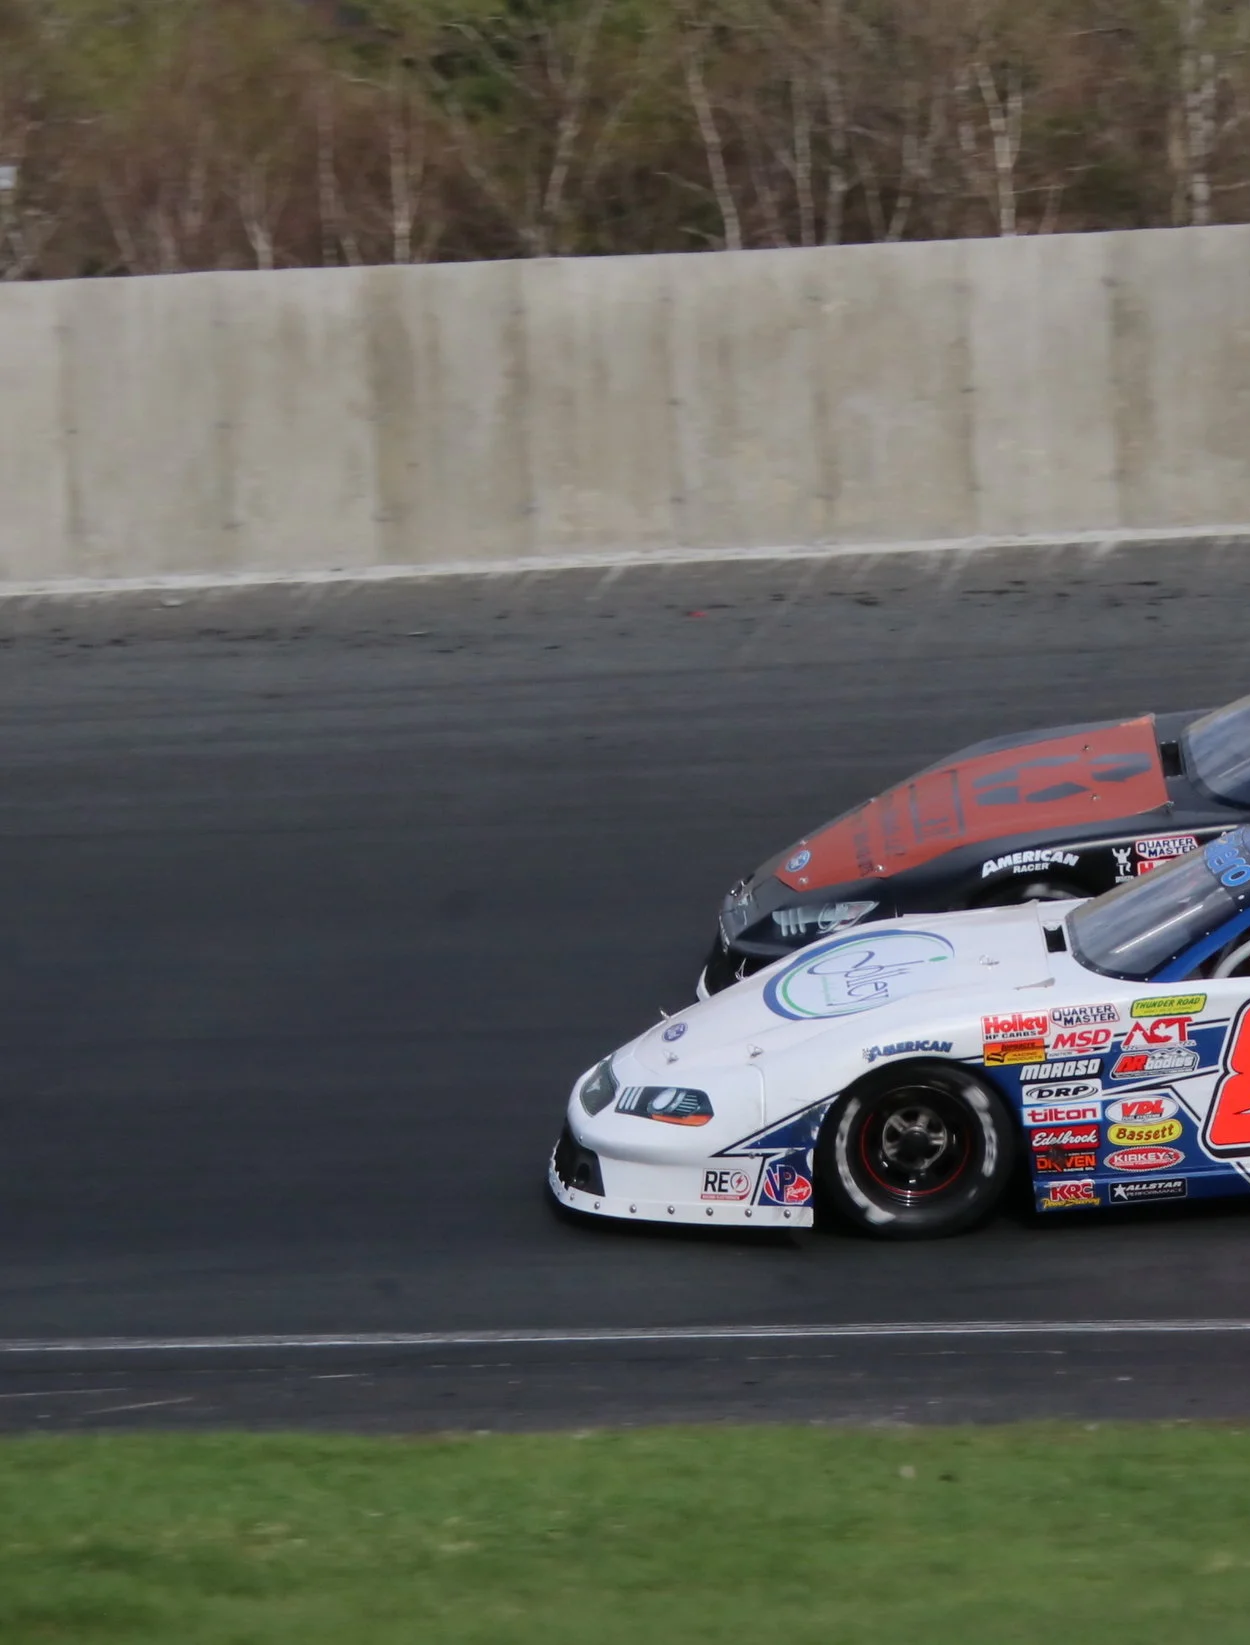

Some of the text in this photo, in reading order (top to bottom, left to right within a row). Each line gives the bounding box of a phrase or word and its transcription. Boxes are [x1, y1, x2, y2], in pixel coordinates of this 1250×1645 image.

[1137, 838, 1193, 853] QUARTER
[982, 849, 1079, 878] AMERICAN
[1013, 862, 1050, 874] RACER
[1136, 1000, 1175, 1010] THUNDER
[1177, 997, 1201, 1006] ROAD
[1052, 1005, 1112, 1021] QUARTER
[1063, 1012, 1116, 1027] MASTER
[984, 1013, 1048, 1035] Holley
[1122, 1016, 1193, 1046] ACT
[1002, 1030, 1037, 1038] CARBS
[1052, 1029, 1111, 1050] MSD
[868, 1040, 954, 1062] AMERICAN
[1020, 1058, 1101, 1080] MOROSO
[1037, 1085, 1090, 1099] DRP
[1028, 1107, 1097, 1122] tilton
[1121, 1099, 1164, 1117] VDL
[1032, 1129, 1098, 1147] Edelbrock
[1116, 1124, 1175, 1141] Bassett
[1036, 1155, 1096, 1171] DRVEN
[1114, 1151, 1165, 1163] KIRKEY
[766, 1165, 797, 1204] VP
[1050, 1181, 1094, 1202] KRC
[1126, 1181, 1183, 1191] ALLSTAR
[1126, 1187, 1184, 1197] PERFORMANCE
